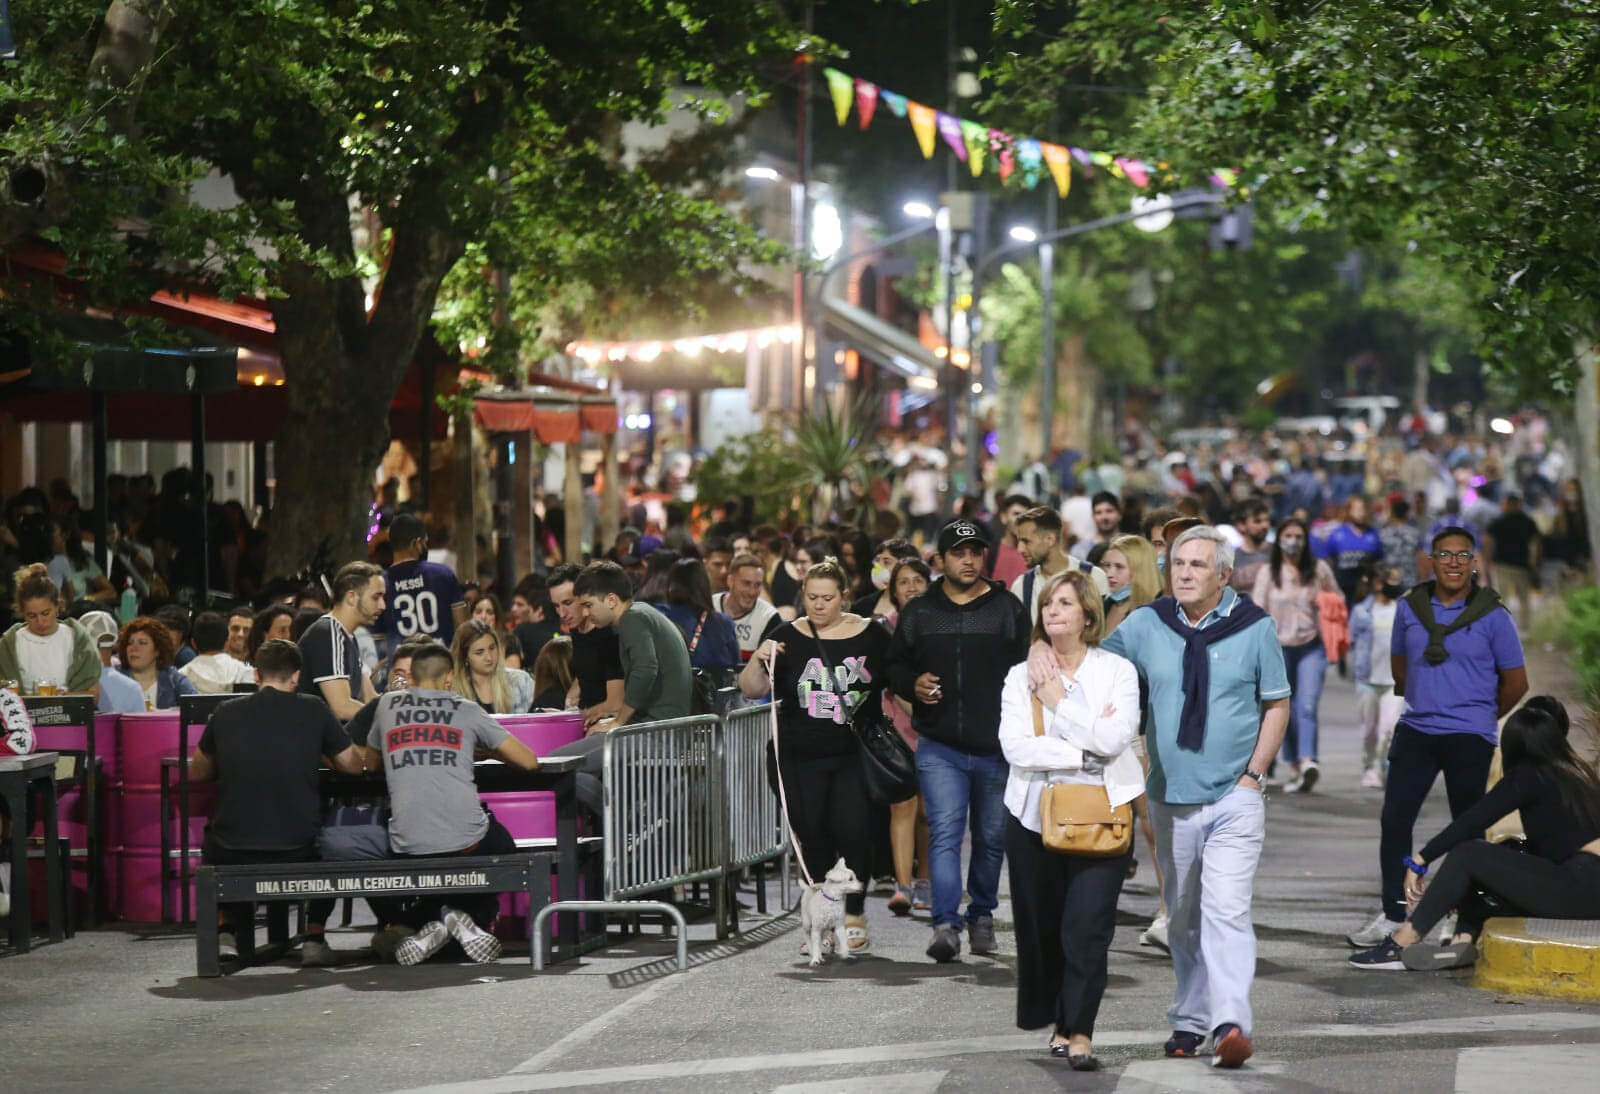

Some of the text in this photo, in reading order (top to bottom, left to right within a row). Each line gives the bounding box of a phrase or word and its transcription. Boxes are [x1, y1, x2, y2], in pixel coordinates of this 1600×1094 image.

[394, 591, 439, 637] 30
[389, 694, 462, 710] PARTY
[396, 709, 454, 726] NOW
[389, 727, 459, 747] REHAB
[390, 749, 457, 769] LATER
[256, 881, 280, 894] UNA
[337, 878, 361, 891] UNA
[418, 874, 442, 887] UNA
[444, 871, 490, 886] PASIÓN.
